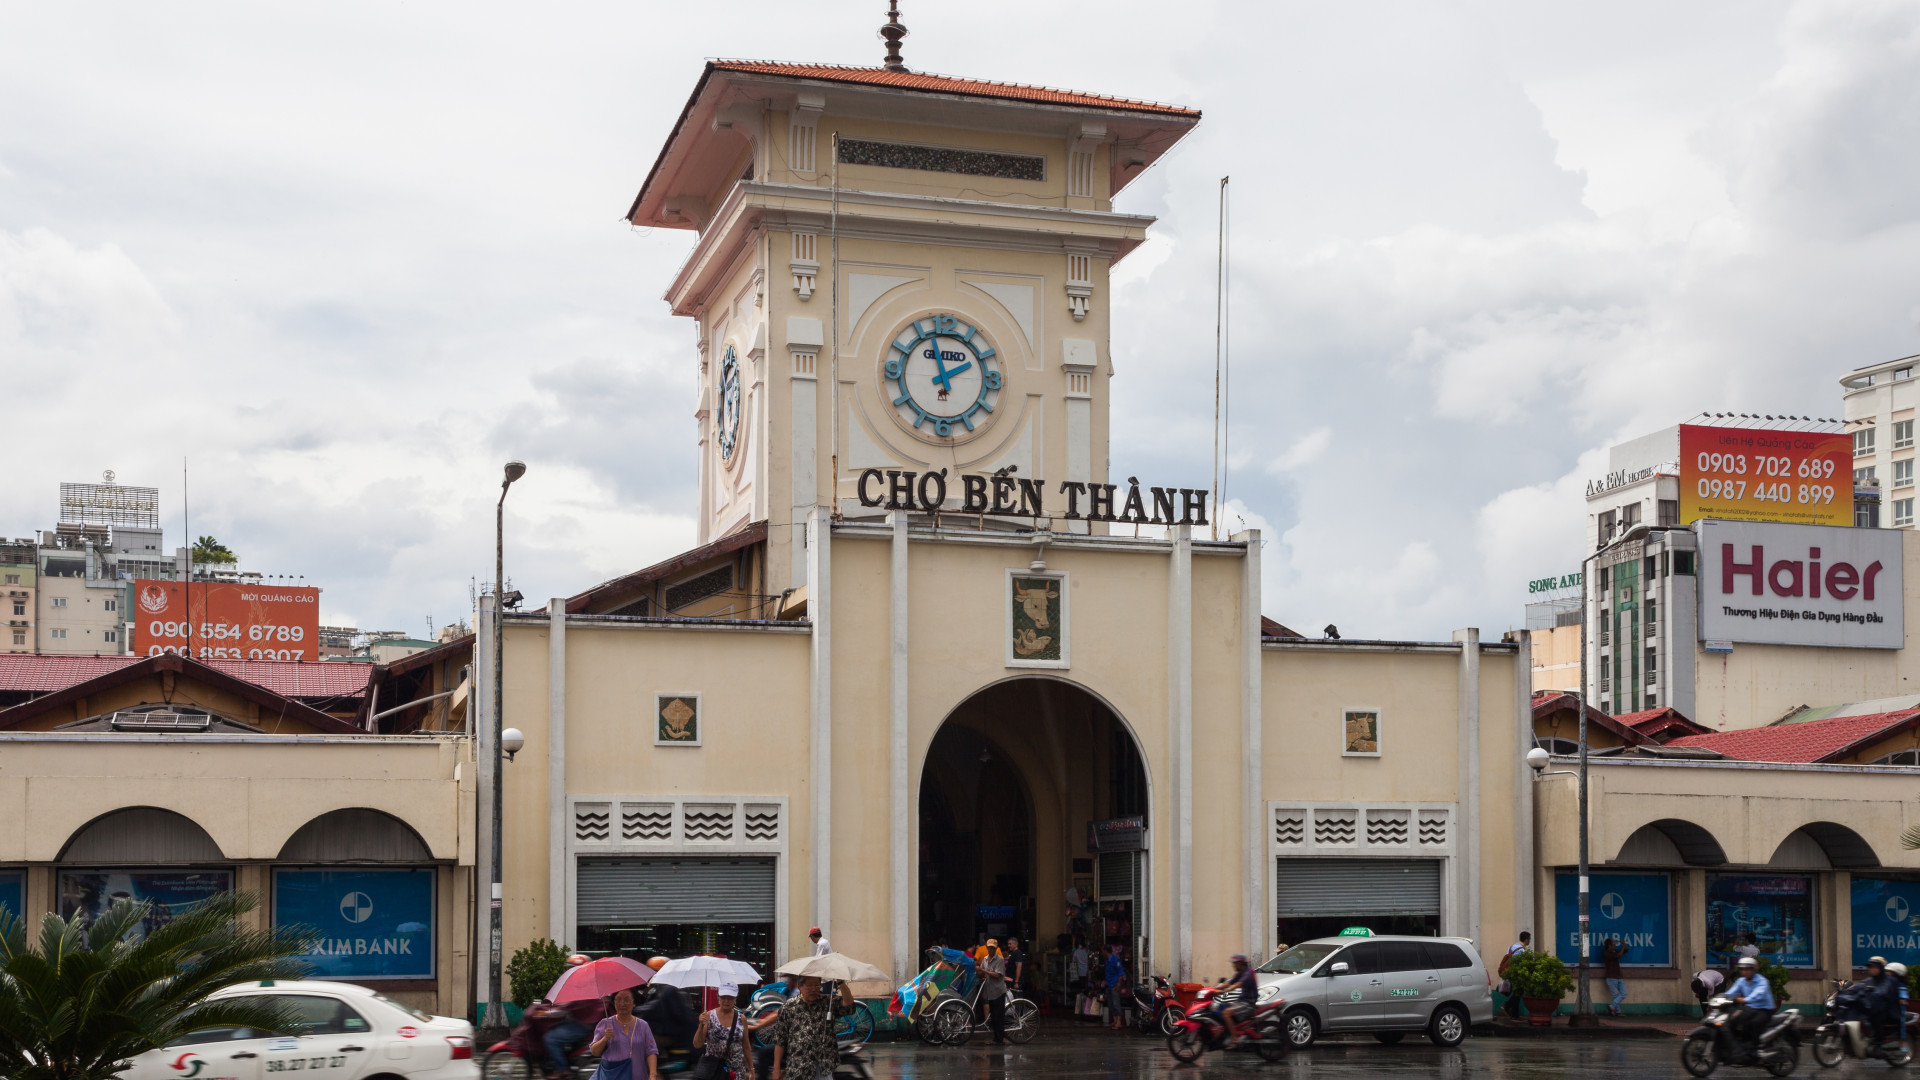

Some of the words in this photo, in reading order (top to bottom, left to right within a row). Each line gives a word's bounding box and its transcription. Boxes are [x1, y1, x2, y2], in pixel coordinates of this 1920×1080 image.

[932, 315, 959, 335] 12
[884, 360, 902, 380] 9
[985, 370, 1002, 390] 3
[935, 418, 952, 437] 6
[1697, 452, 1747, 475] 0903
[1755, 456, 1792, 478] 702
[1797, 458, 1835, 480] 689
[857, 466, 948, 516] CHỢ
[962, 464, 1046, 517] BẾN
[1060, 476, 1209, 526] THÀNH
[1697, 478, 1747, 501] 0987
[1753, 482, 1792, 504] 440
[1797, 484, 1835, 506] 899
[1722, 543, 1883, 601] Haier
[1529, 576, 1557, 593] SONG
[1722, 606, 1757, 620] Thương
[1759, 608, 1778, 620] Hiệu
[1780, 608, 1800, 621] Điện
[1802, 610, 1816, 620] Gia
[1818, 611, 1841, 624] Dụng
[1842, 611, 1865, 625] Hàng
[149, 620, 193, 639] 090
[200, 623, 242, 641] 554
[249, 624, 305, 643] 6789
[1570, 932, 1655, 947] EIMBANK
[1856, 934, 1920, 949] EXIMBA
